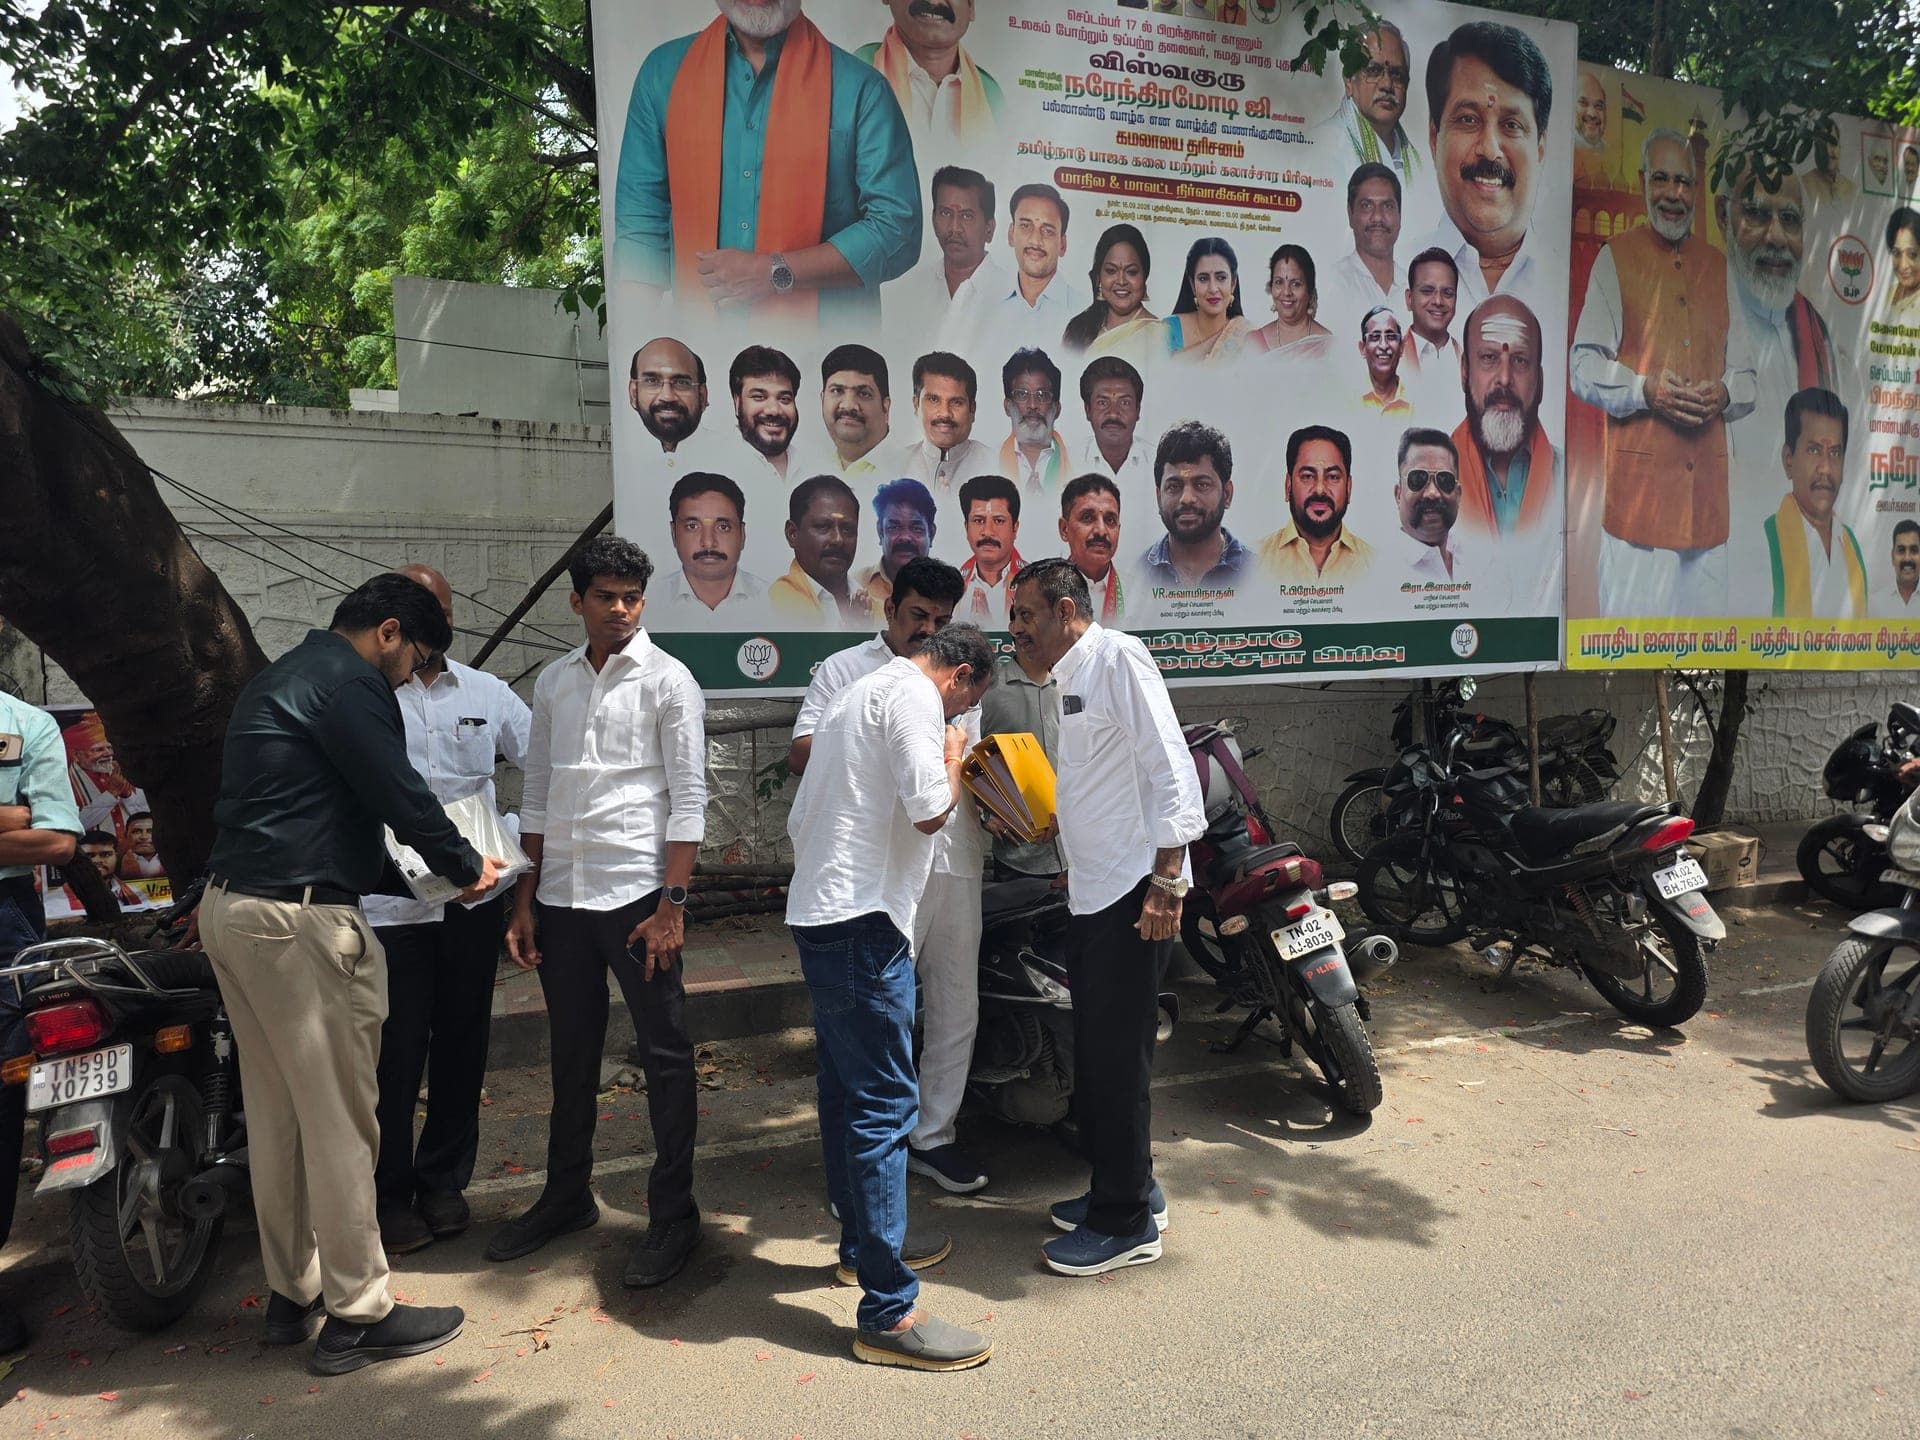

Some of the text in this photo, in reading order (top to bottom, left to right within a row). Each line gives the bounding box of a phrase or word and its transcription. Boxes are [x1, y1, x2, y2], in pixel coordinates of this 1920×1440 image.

[1008, 15, 1051, 34] உலகம்
[1056, 23, 1108, 44] போற்றும்
[1113, 32, 1154, 50] ஒப்பற்ற
[1214, 49, 1241, 66] நமது
[1245, 54, 1272, 69] பாரத
[1067, 9, 1263, 50] செப்டம்பர் 17 ல் பிறந்தநாள் காணும்
[1089, 50, 1246, 92] விஸ்வகுரு
[1064, 72, 1240, 121] நரேந்திரமோடி
[1244, 96, 1271, 120] ஜி
[1042, 99, 1106, 121] பல்லாண்டு
[1110, 109, 1145, 125] வாழ்க
[1149, 115, 1171, 128] என
[1176, 117, 1217, 134] வாழ்த்தி
[1116, 129, 1245, 158] கமலாலய தரிசனம்
[1016, 138, 1086, 163] தமிழ்நாடு
[1089, 150, 1128, 166] பாஜக
[1132, 154, 1166, 169] கலை
[1170, 160, 1217, 178] மற்றும்
[1220, 164, 1280, 184] கலாச்சார
[1282, 170, 1312, 188] பிரிவு
[1060, 170, 1297, 208] மாநில & மாவட்ட நிர்வாகிகள் கூட்டம்
[1844, 286, 1860, 298] BJP
[1870, 364, 1911, 384] செப்டம்பர்
[1141, 630, 1303, 653] மிழ்நாடு
[1312, 645, 1406, 663] பிரிவு
[1580, 626, 1639, 663] பாரதிய
[1643, 630, 1698, 662] ஜனதா
[1702, 626, 1737, 653] கட்சி
[1750, 626, 1800, 660] மத்திய
[1804, 626, 1872, 652] சென்னை
[1286, 920, 1322, 940] TN-02
[1288, 930, 1334, 956] AJ-8039
[51, 1050, 117, 1081] TN59D
[51, 1070, 118, 1103] X0739
